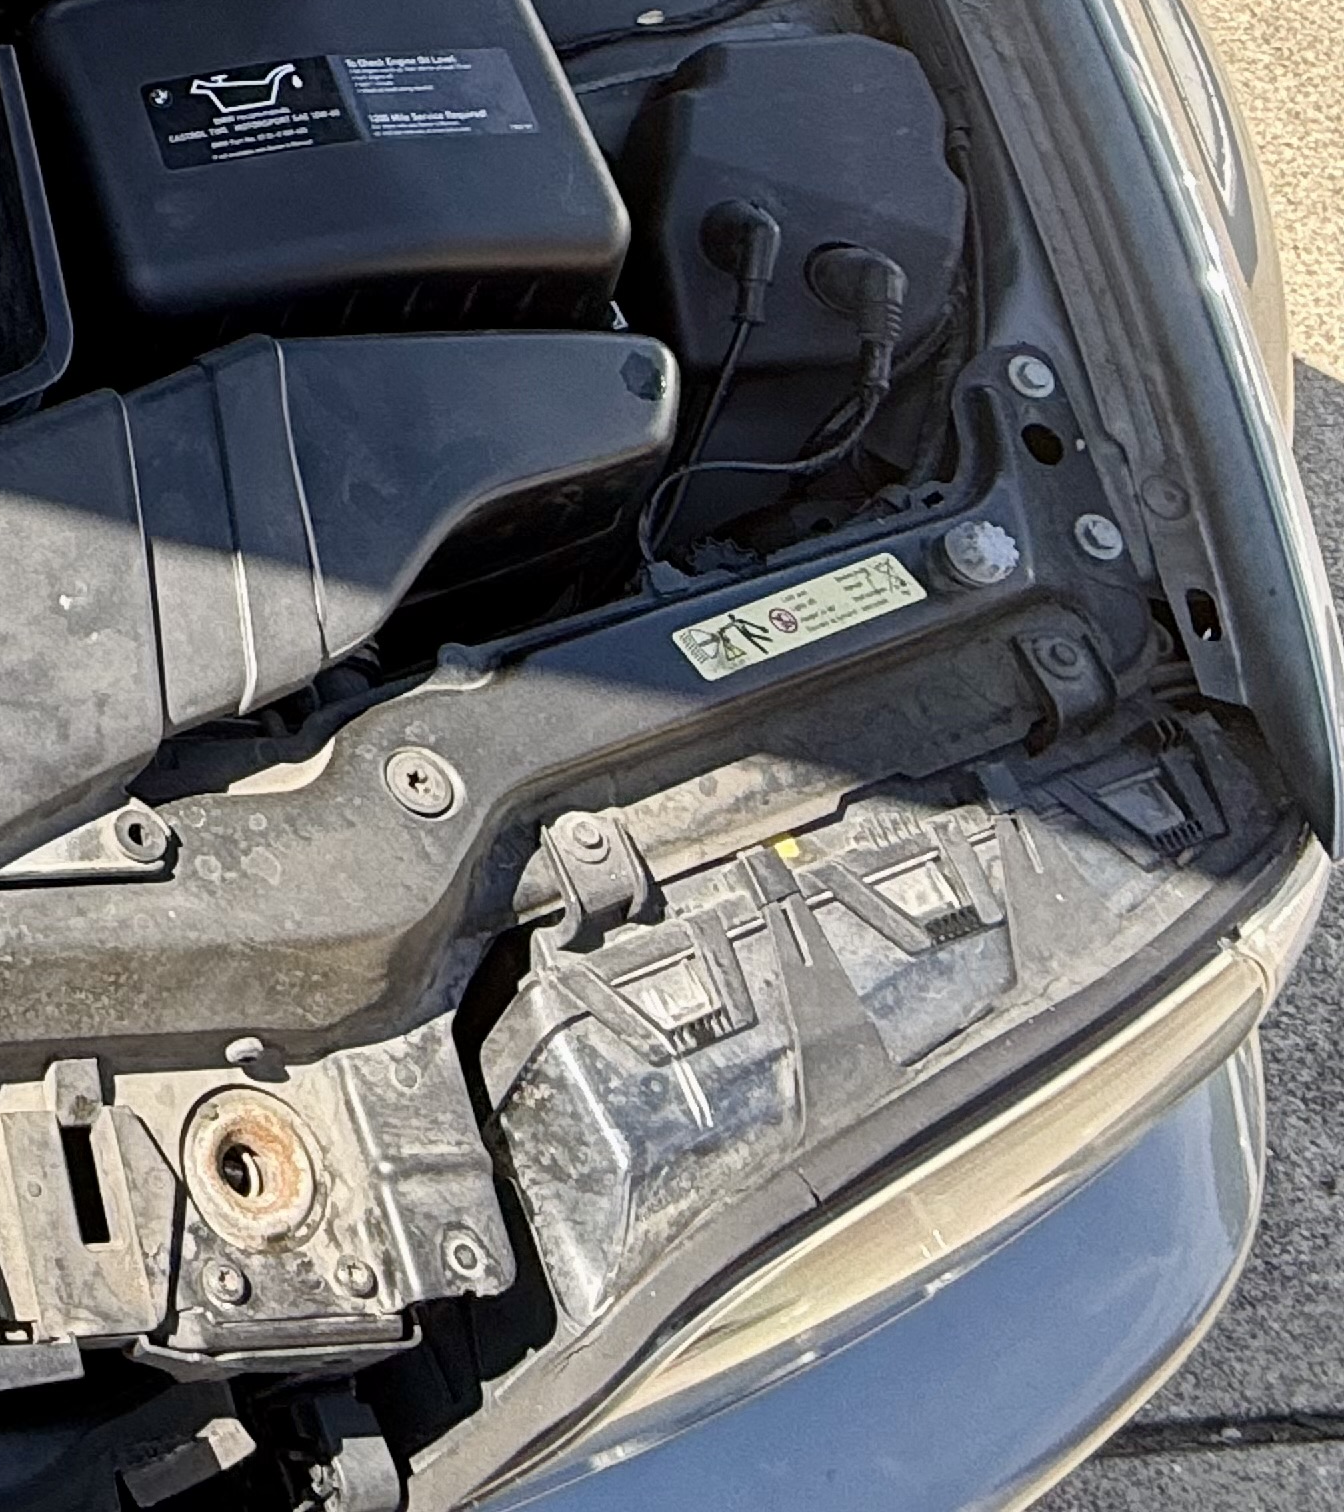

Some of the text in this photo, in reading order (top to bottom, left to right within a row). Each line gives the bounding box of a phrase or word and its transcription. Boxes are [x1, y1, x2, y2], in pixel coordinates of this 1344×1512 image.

[357, 58, 385, 68] Check
[384, 56, 416, 67] Engine
[410, 111, 445, 122] Service
